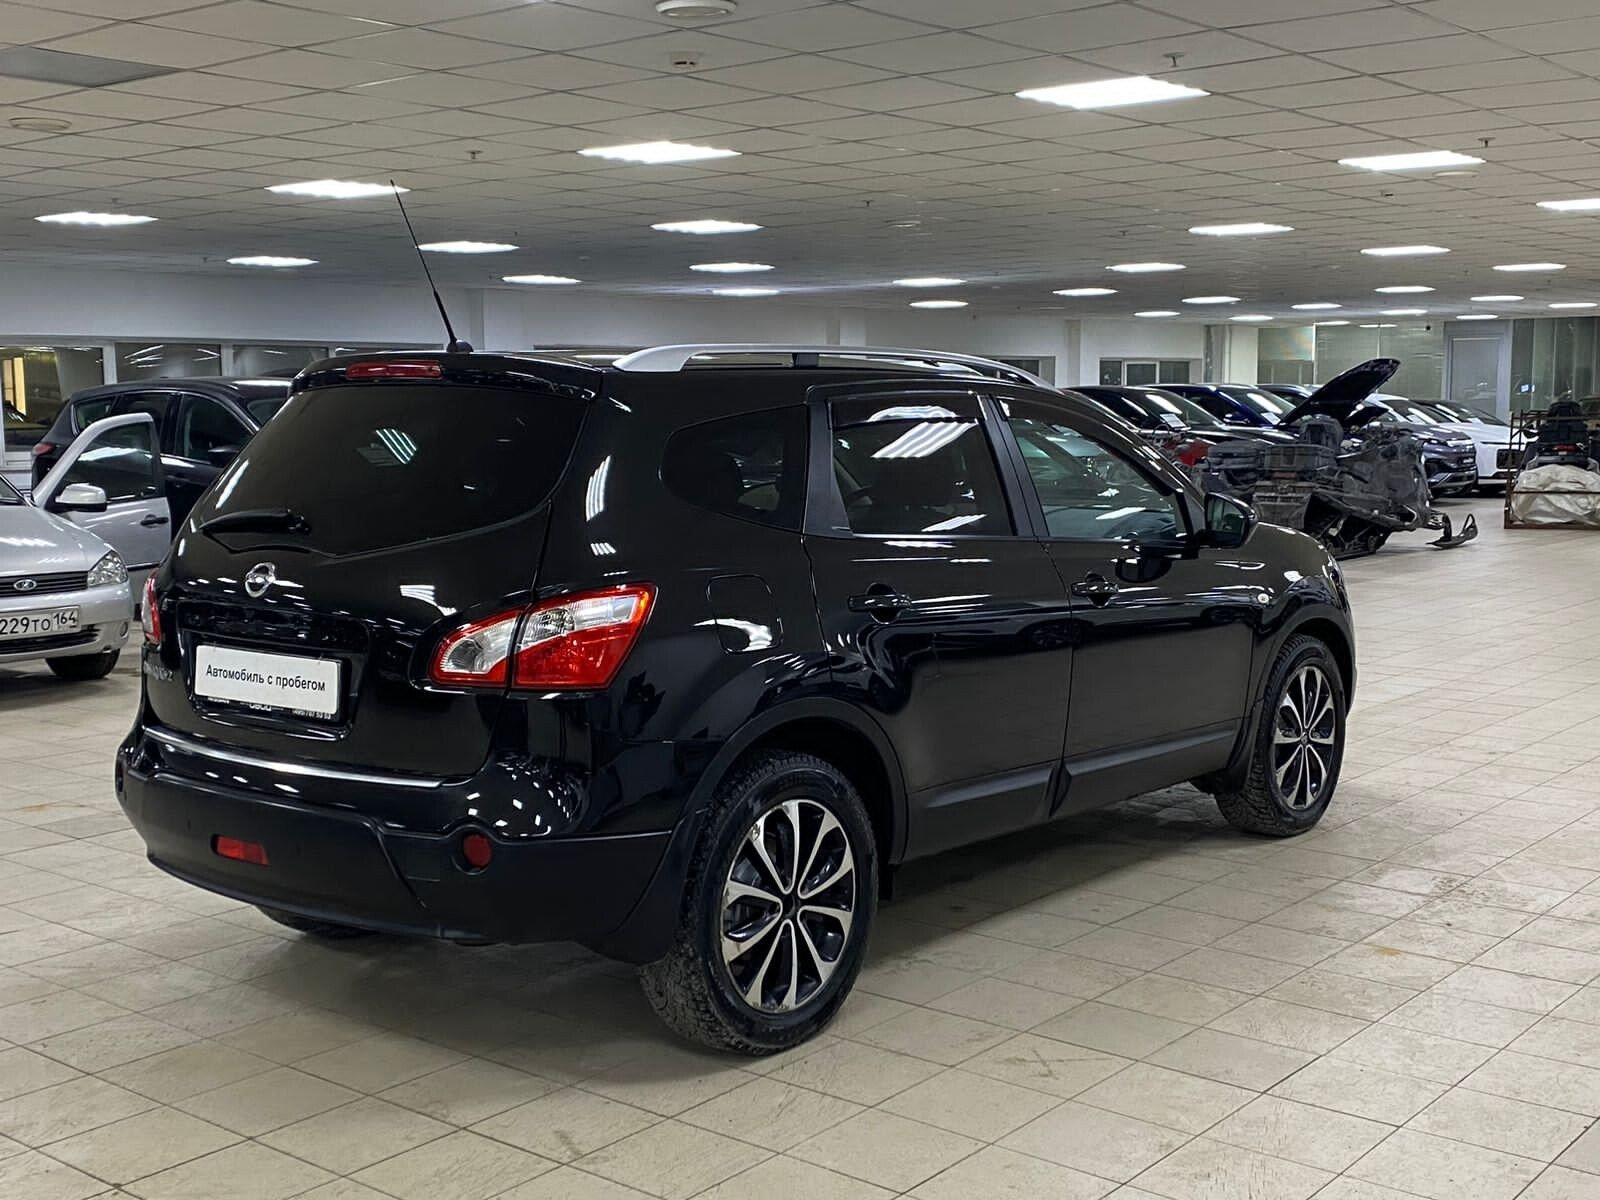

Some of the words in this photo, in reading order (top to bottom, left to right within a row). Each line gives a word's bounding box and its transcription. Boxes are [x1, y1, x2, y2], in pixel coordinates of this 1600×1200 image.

[206, 664, 265, 685] Автомобиль
[267, 675, 273, 685] с
[275, 675, 326, 691] пробегом
